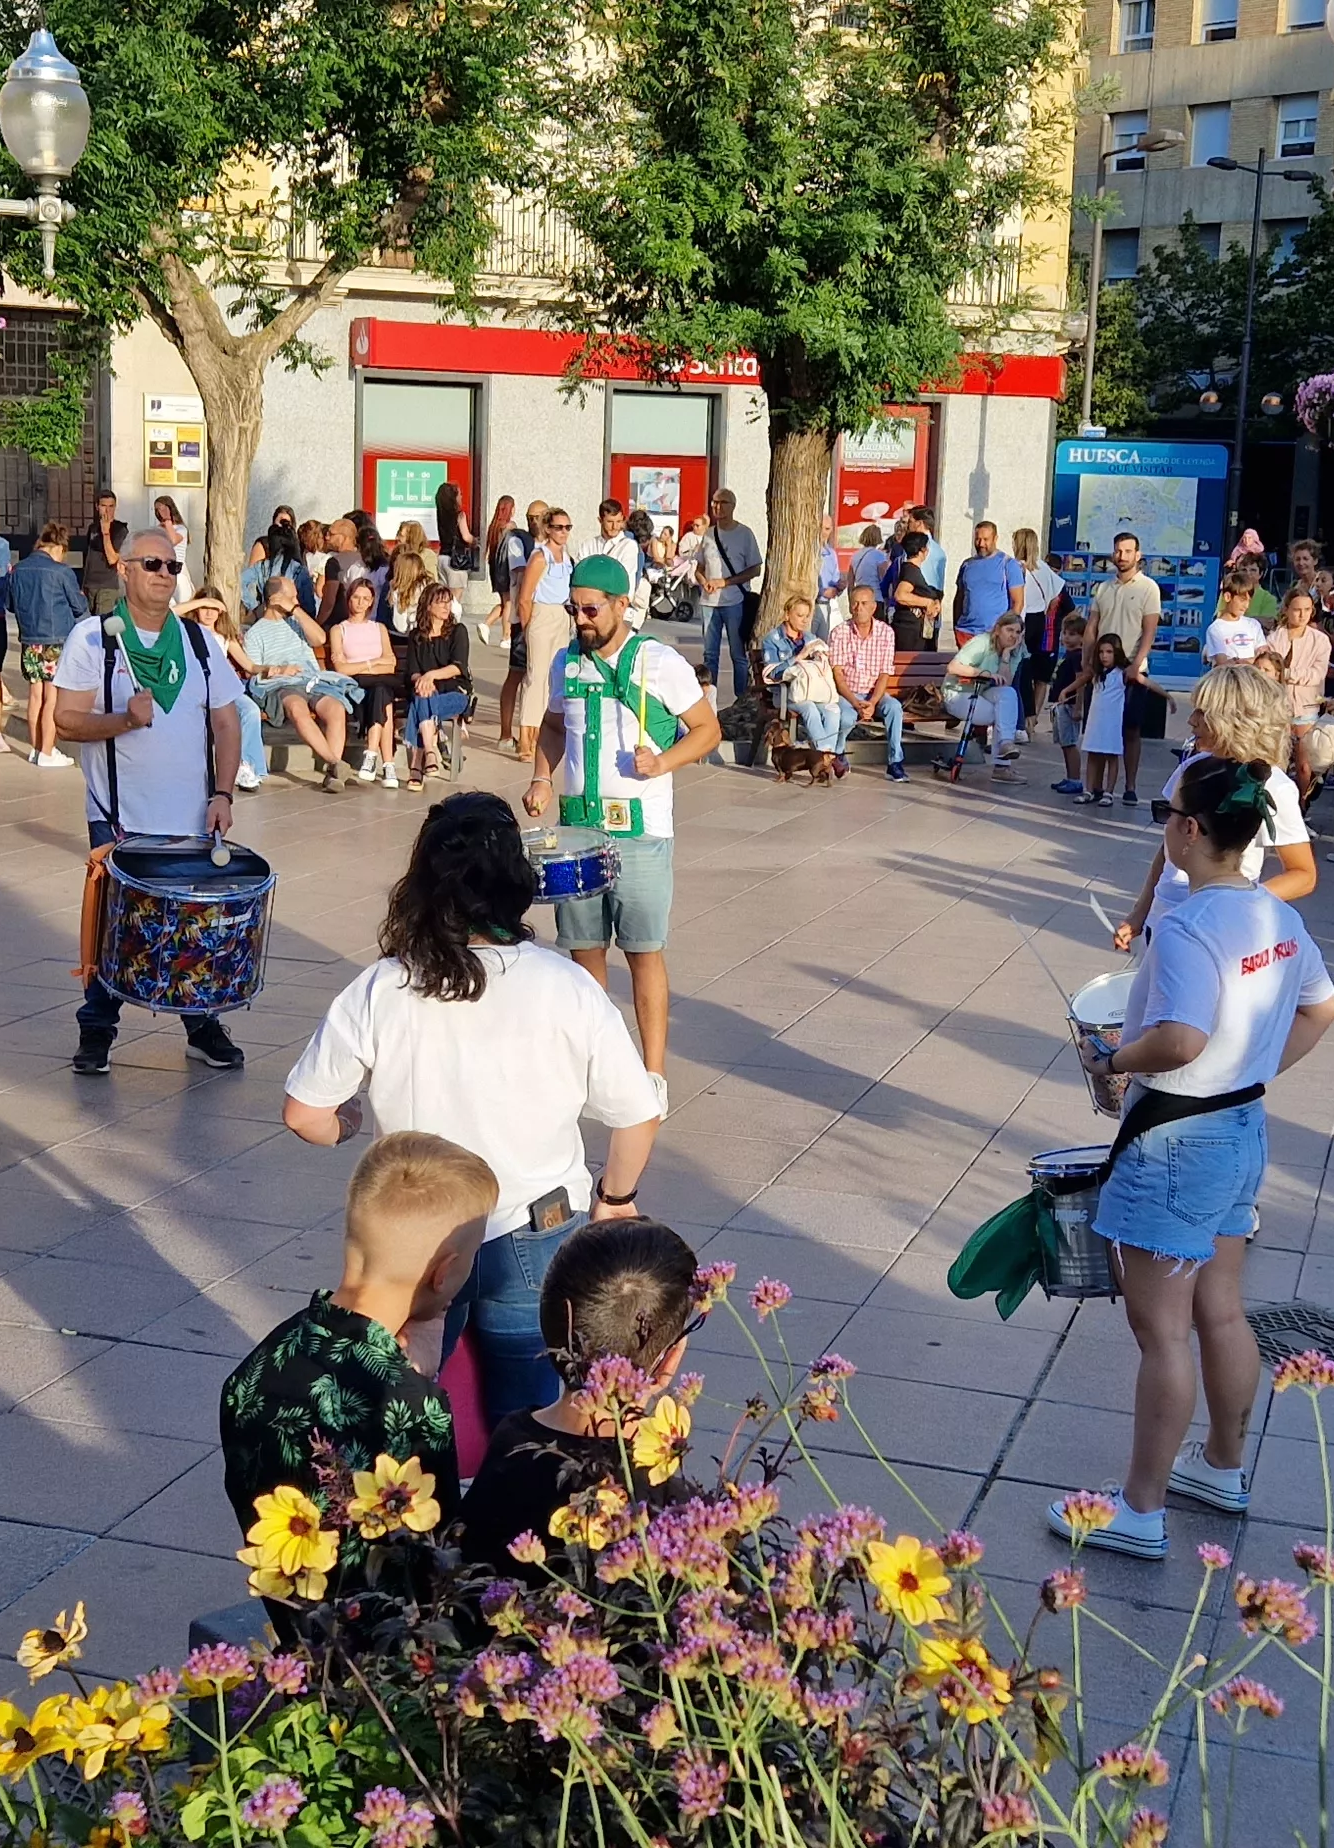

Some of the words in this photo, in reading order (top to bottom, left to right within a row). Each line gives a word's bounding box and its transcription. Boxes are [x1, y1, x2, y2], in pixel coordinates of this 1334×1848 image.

[1069, 448, 1141, 464] HUESCA
[1142, 456, 1169, 465] CIUDAD
[1171, 457, 1182, 465] DE
[1133, 465, 1174, 475] VISITAR
